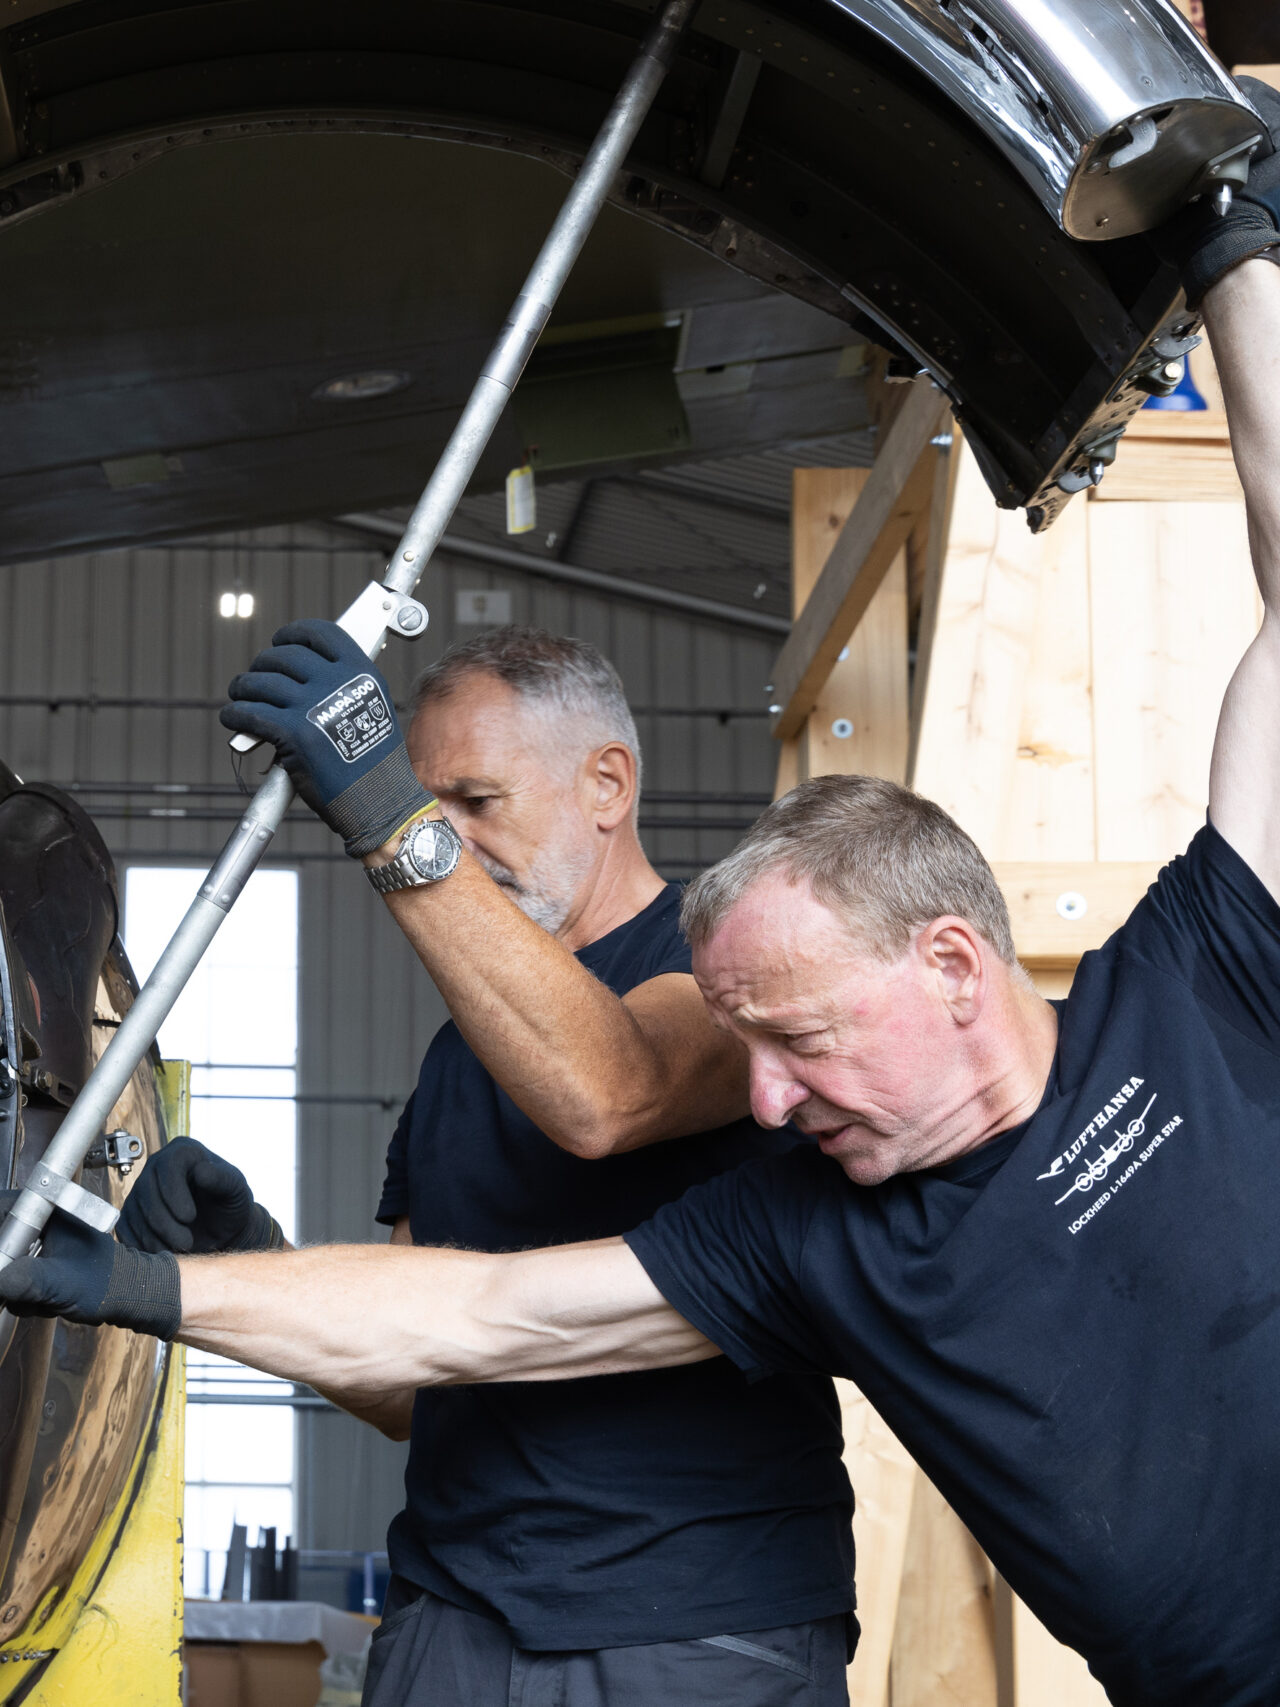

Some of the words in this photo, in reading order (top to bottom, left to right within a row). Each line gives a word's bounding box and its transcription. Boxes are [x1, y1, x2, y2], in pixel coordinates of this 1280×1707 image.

[316, 695, 356, 725] MAPA
[351, 680, 375, 700] 500
[340, 700, 365, 718] ULTRANE
[1063, 1076, 1145, 1164] LUFTHANSA
[1068, 1191, 1111, 1235] LOCKHEED
[1109, 1160, 1143, 1194] L-1649A
[1138, 1134, 1165, 1162] SUPER
[1161, 1115, 1184, 1137] STAR
